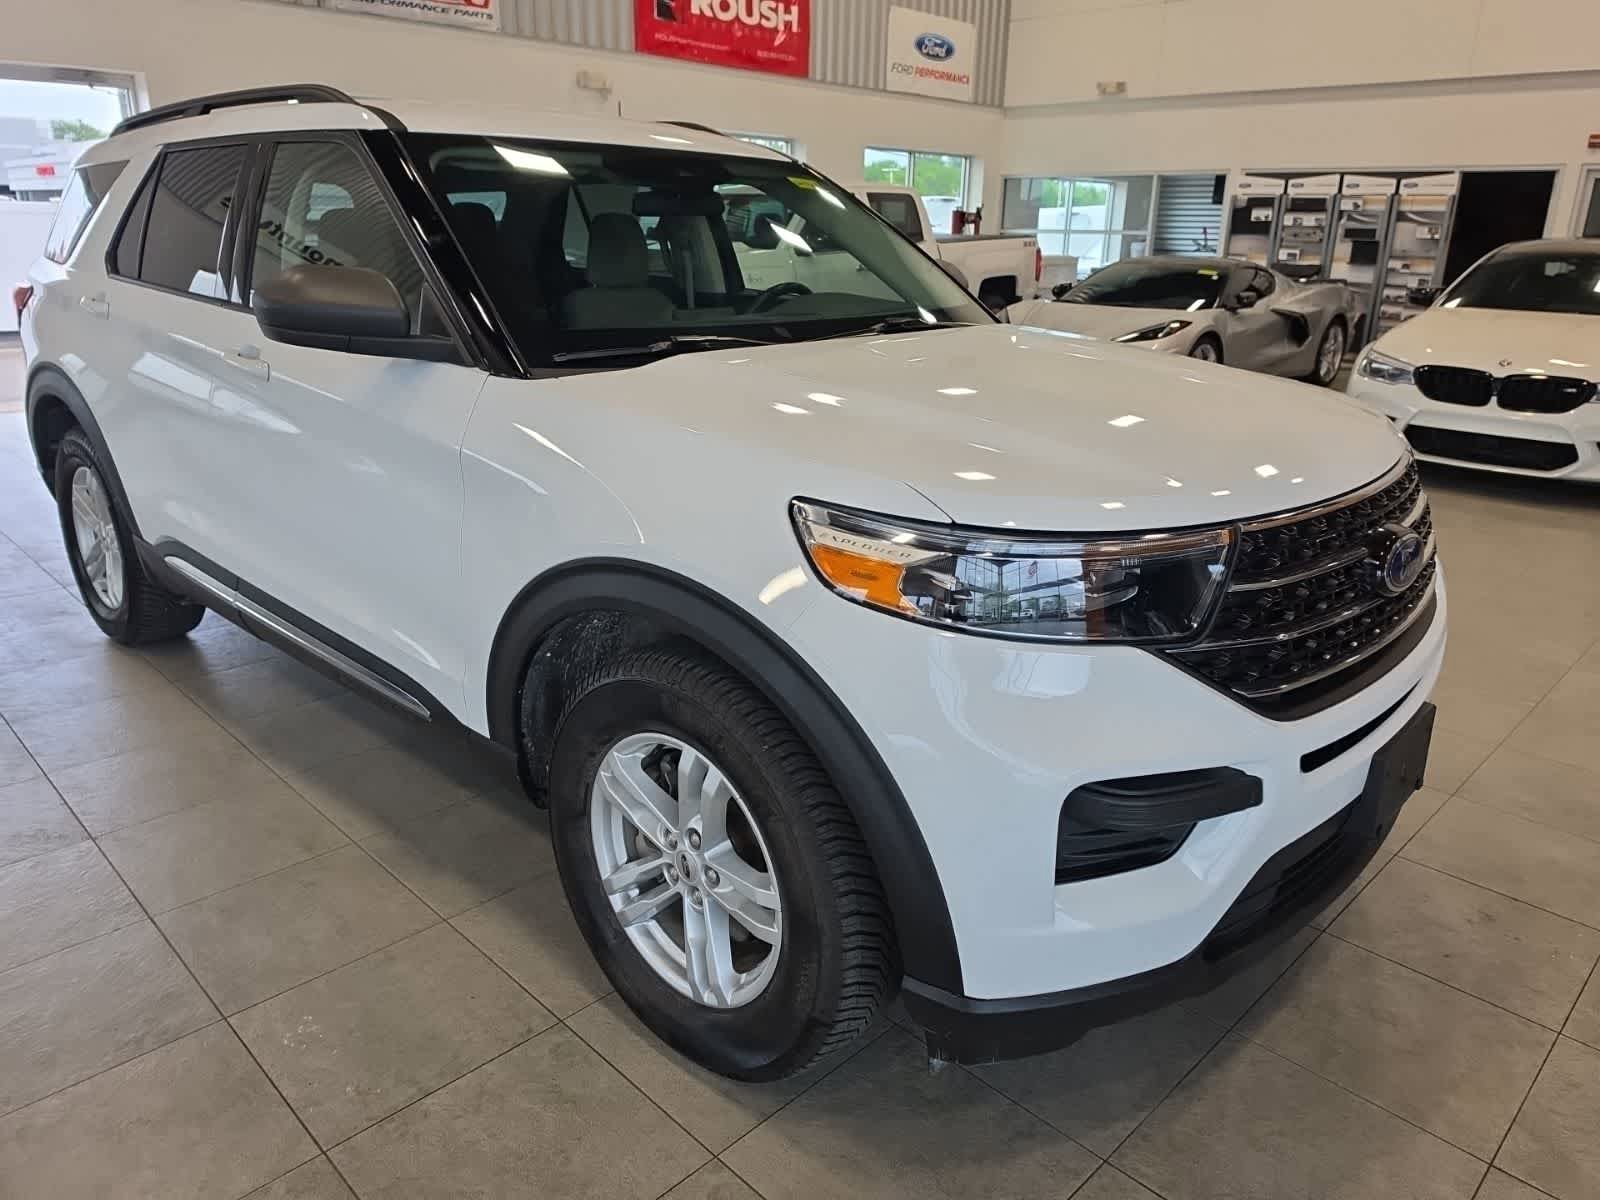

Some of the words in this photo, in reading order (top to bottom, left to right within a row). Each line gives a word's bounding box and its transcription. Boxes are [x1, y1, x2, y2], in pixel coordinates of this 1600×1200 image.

[354, 0, 449, 14] FORMANCE
[454, 8, 493, 20] PARTS
[690, 0, 800, 33] ROUSH
[890, 62, 914, 76] FORD
